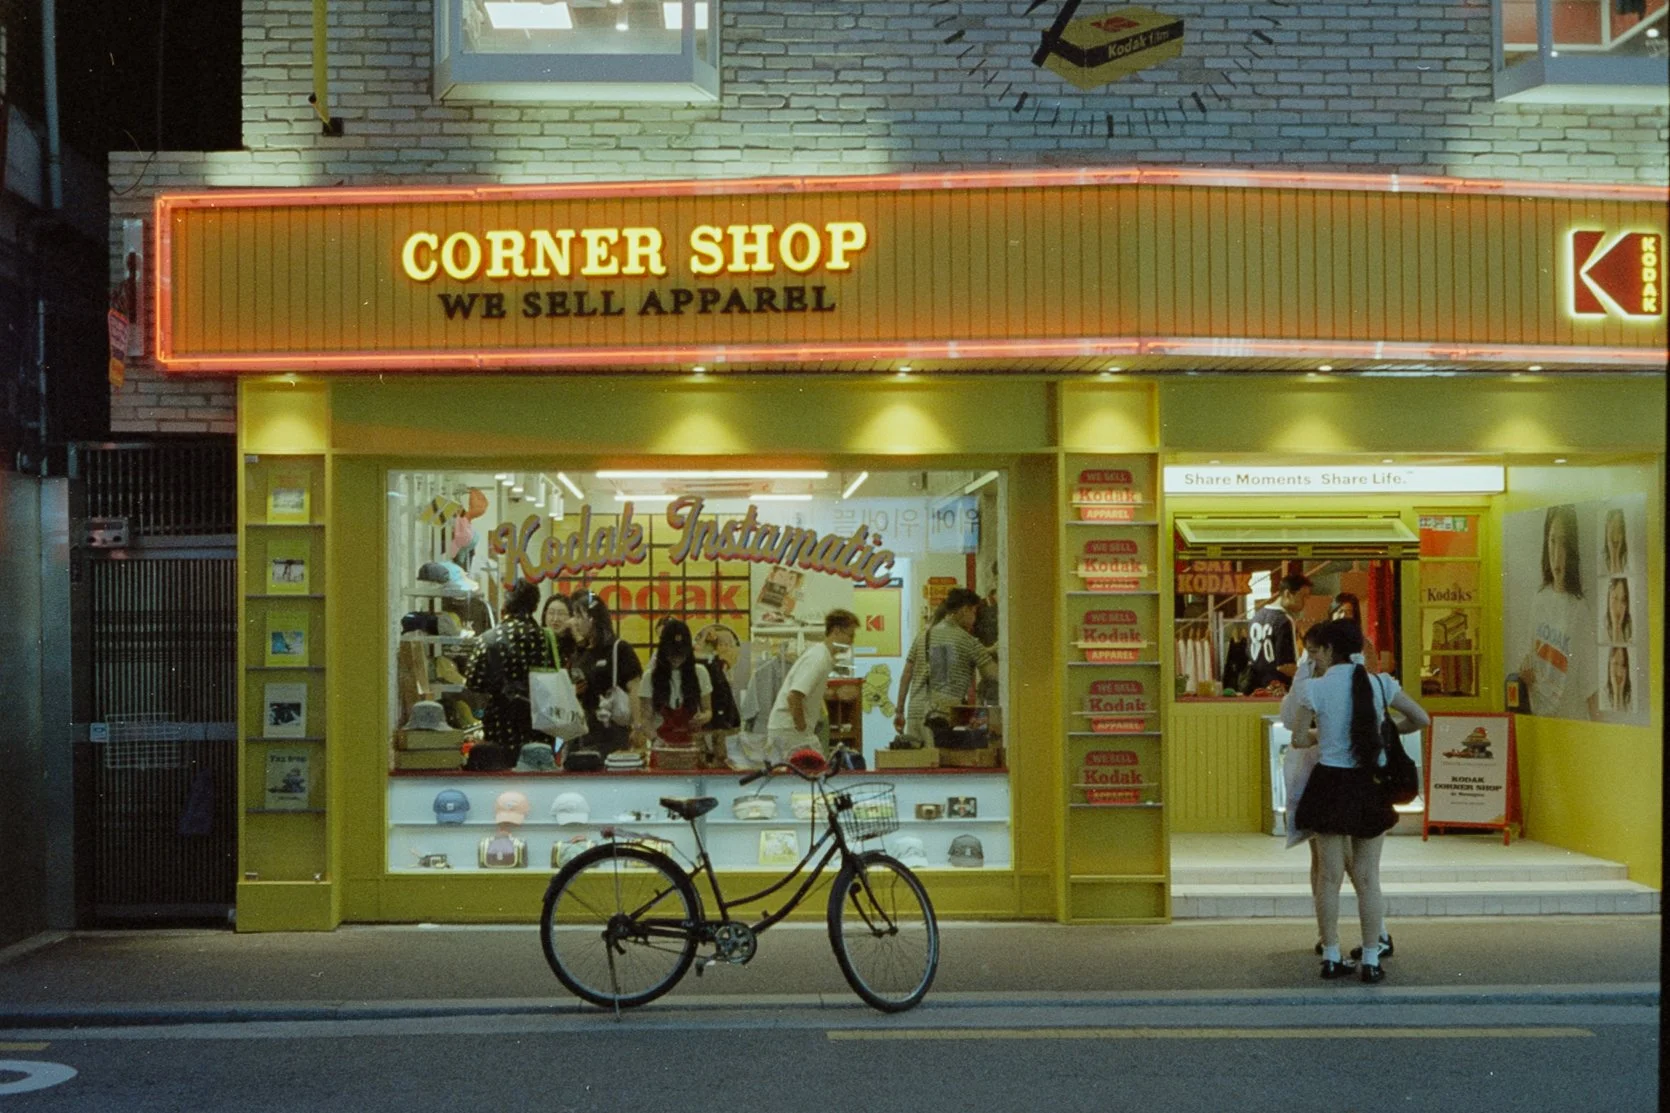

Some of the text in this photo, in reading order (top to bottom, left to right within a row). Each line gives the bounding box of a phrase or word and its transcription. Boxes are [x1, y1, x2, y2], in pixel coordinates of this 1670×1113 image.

[1107, 31, 1170, 59] Kodak film
[402, 222, 867, 281] CORNER SHOP
[1641, 236, 1657, 312] KODAK
[437, 285, 837, 320] WE SELL APPAREL
[1185, 473, 1232, 485] Share
[1236, 473, 1312, 485] Moments
[1321, 472, 1368, 485] Share
[1079, 486, 1135, 501] Kodak
[1086, 509, 1130, 519] APPAREL
[492, 494, 896, 592] Kodak Instamatic
[1084, 557, 1142, 573] Kodak
[1177, 574, 1250, 594] KODAK
[1083, 627, 1141, 642] Kodak
[1091, 651, 1135, 660] APPAREL
[1089, 697, 1147, 711] Kodak
[1083, 769, 1143, 784] Kodak
